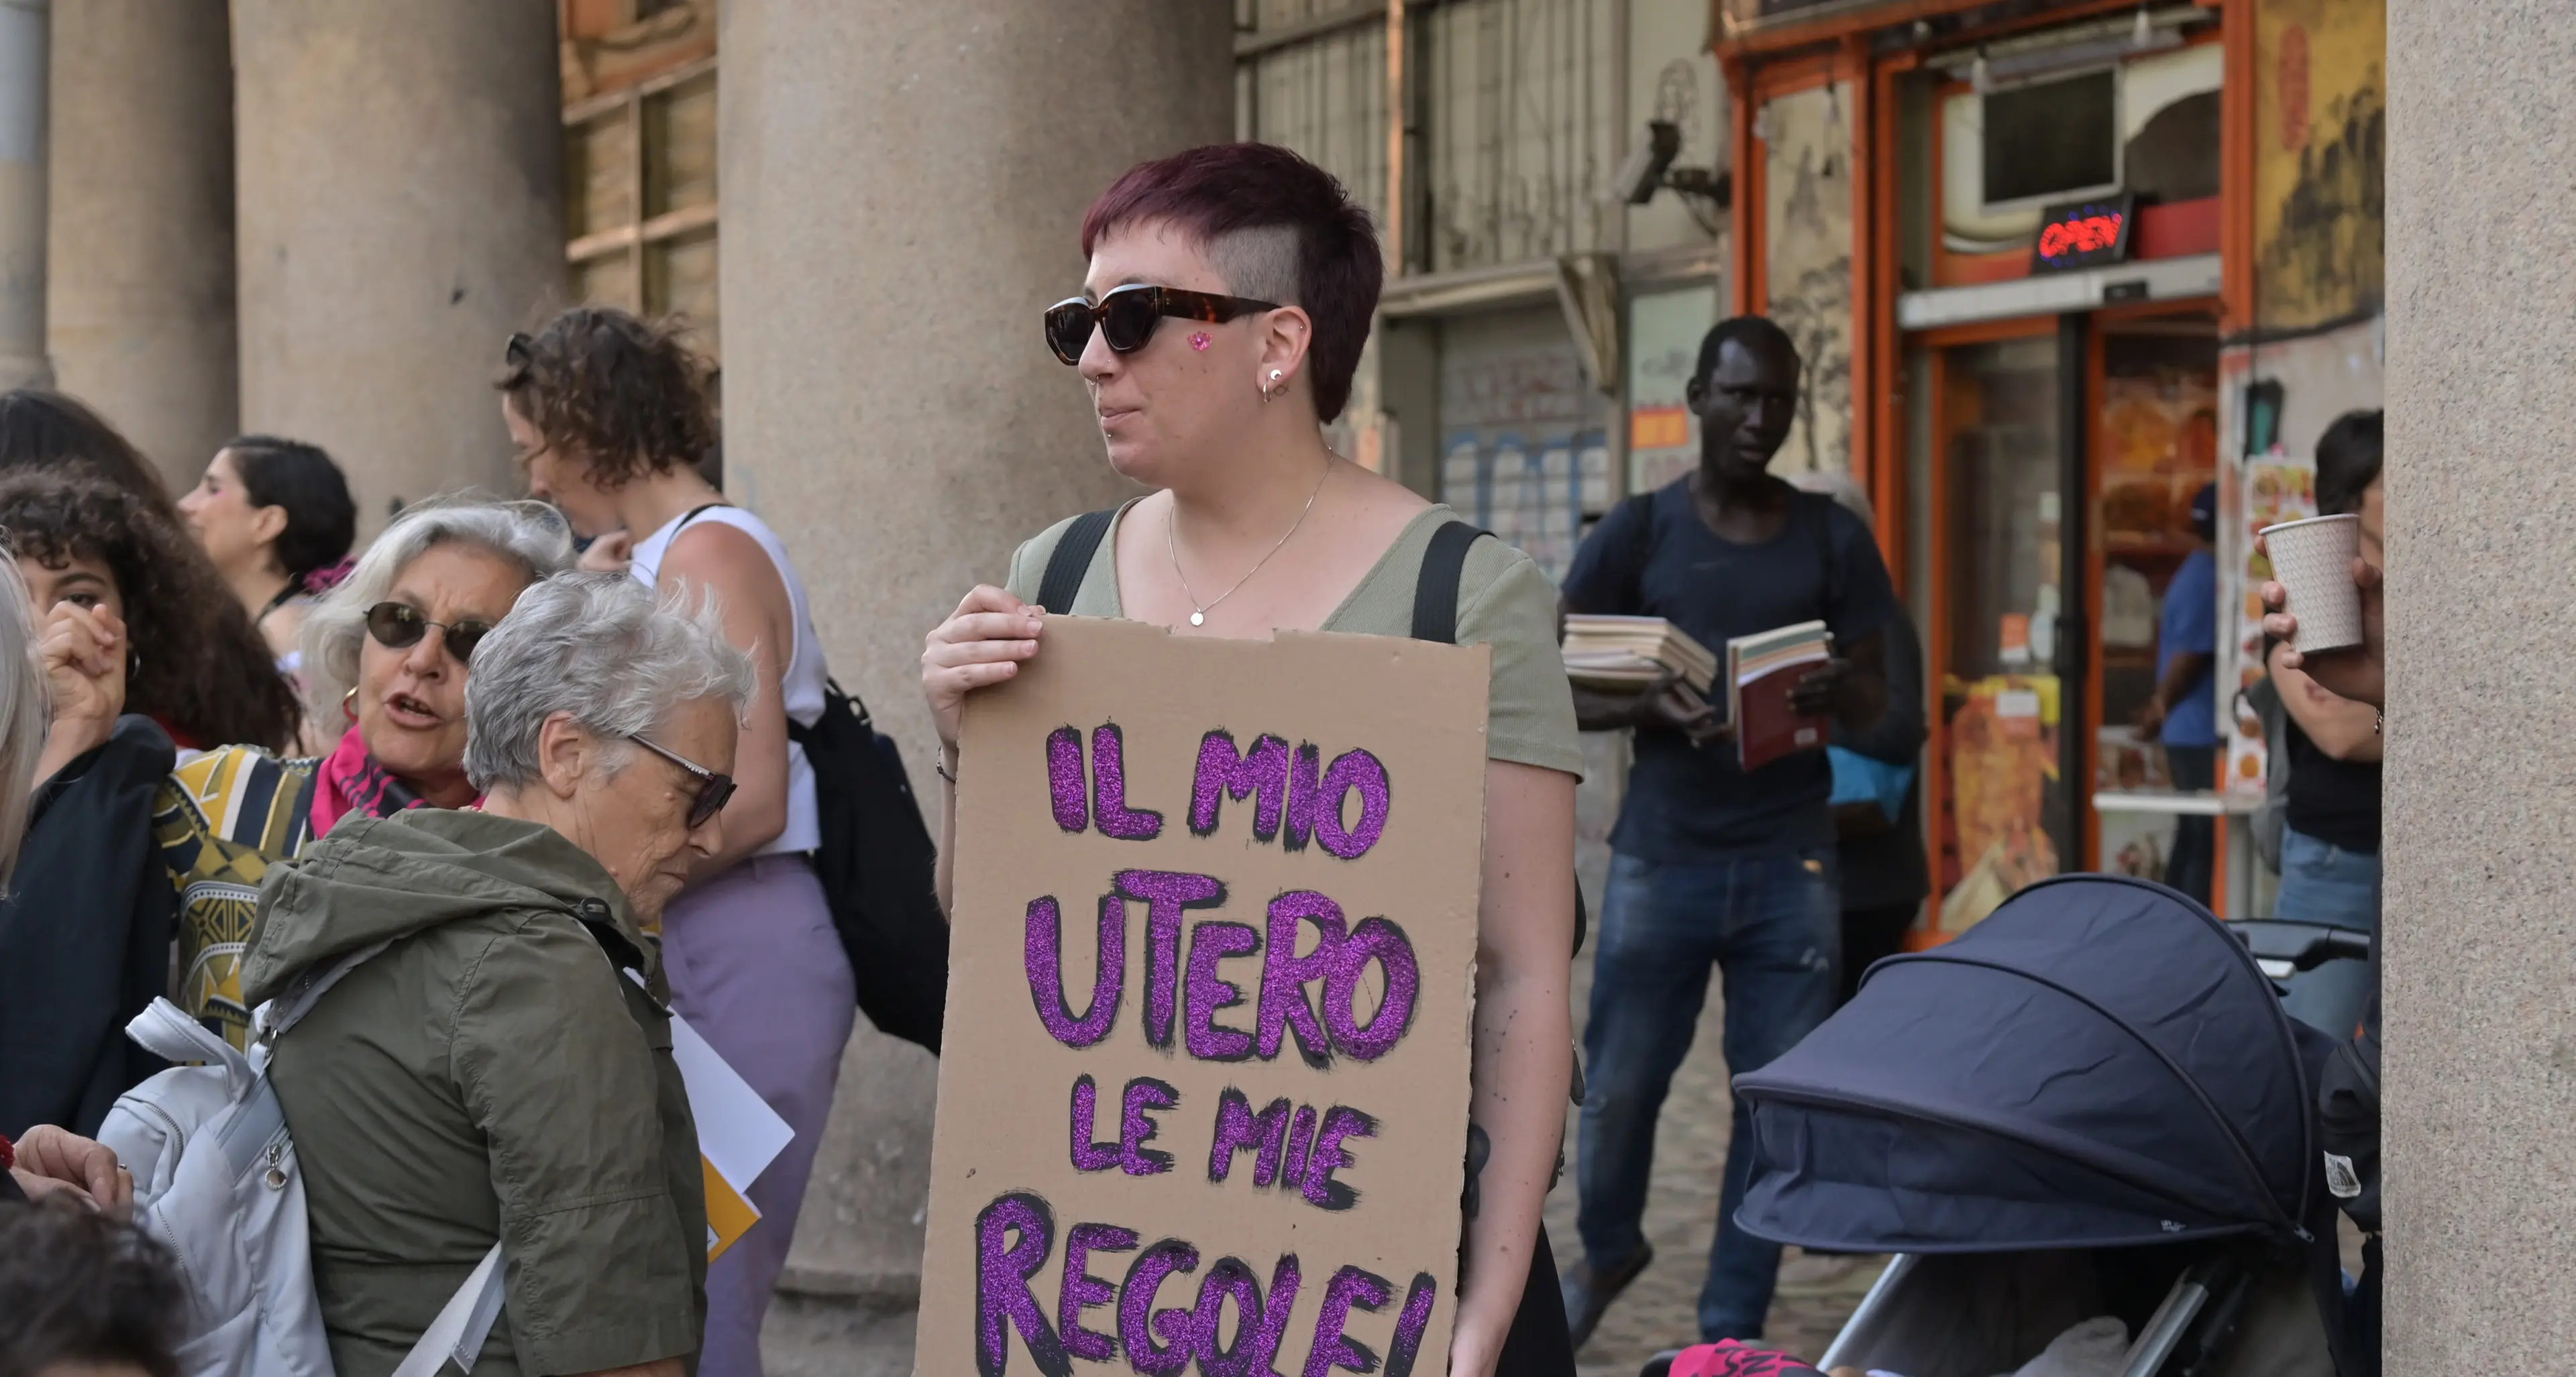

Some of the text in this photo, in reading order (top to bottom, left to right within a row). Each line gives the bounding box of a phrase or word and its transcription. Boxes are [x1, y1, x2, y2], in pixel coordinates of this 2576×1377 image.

[2039, 213, 2123, 258] OPEN
[1046, 722, 1390, 860] IL MIO
[1025, 869, 1419, 1069] UTERO
[1071, 1074, 1375, 1210] LE MIE
